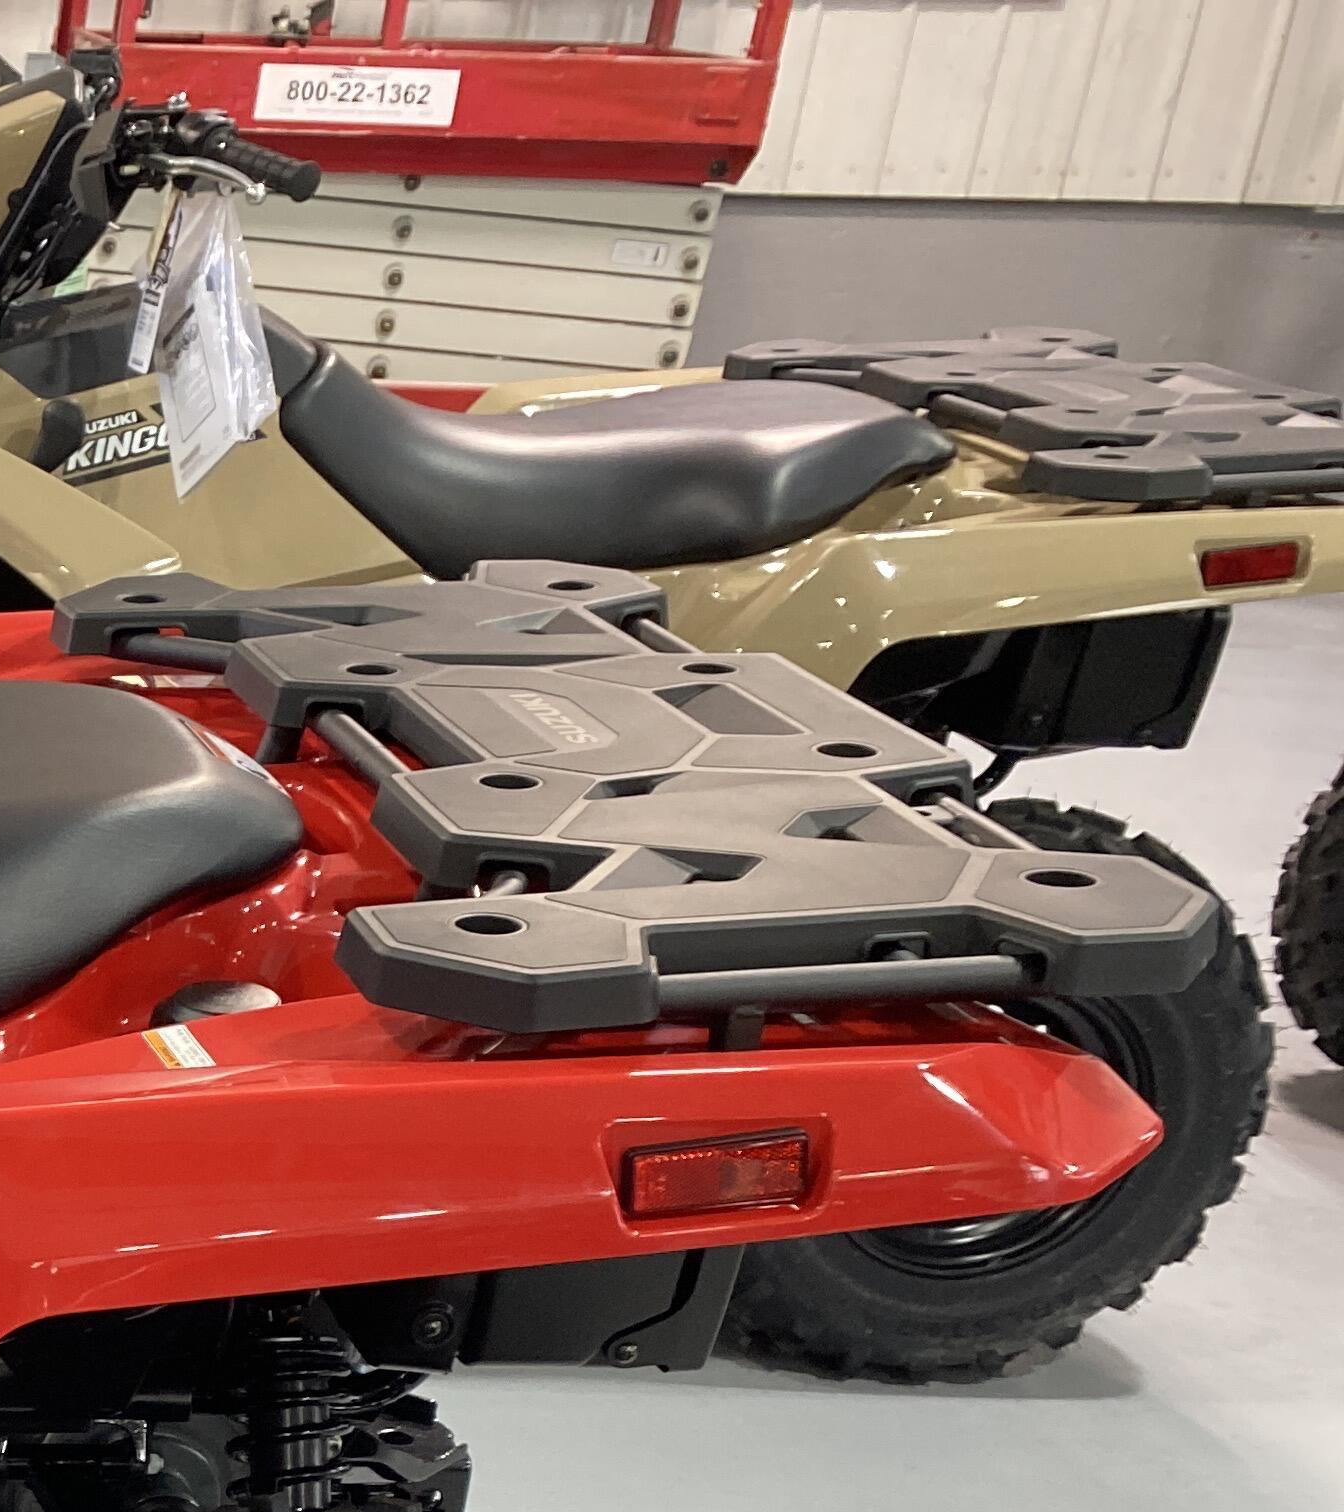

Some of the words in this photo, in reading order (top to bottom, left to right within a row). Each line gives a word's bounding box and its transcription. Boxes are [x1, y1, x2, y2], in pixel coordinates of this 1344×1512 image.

[287, 79, 432, 105] 800-22-1362
[84, 411, 138, 434] UZUKI
[508, 692, 600, 744] SUZUKI
